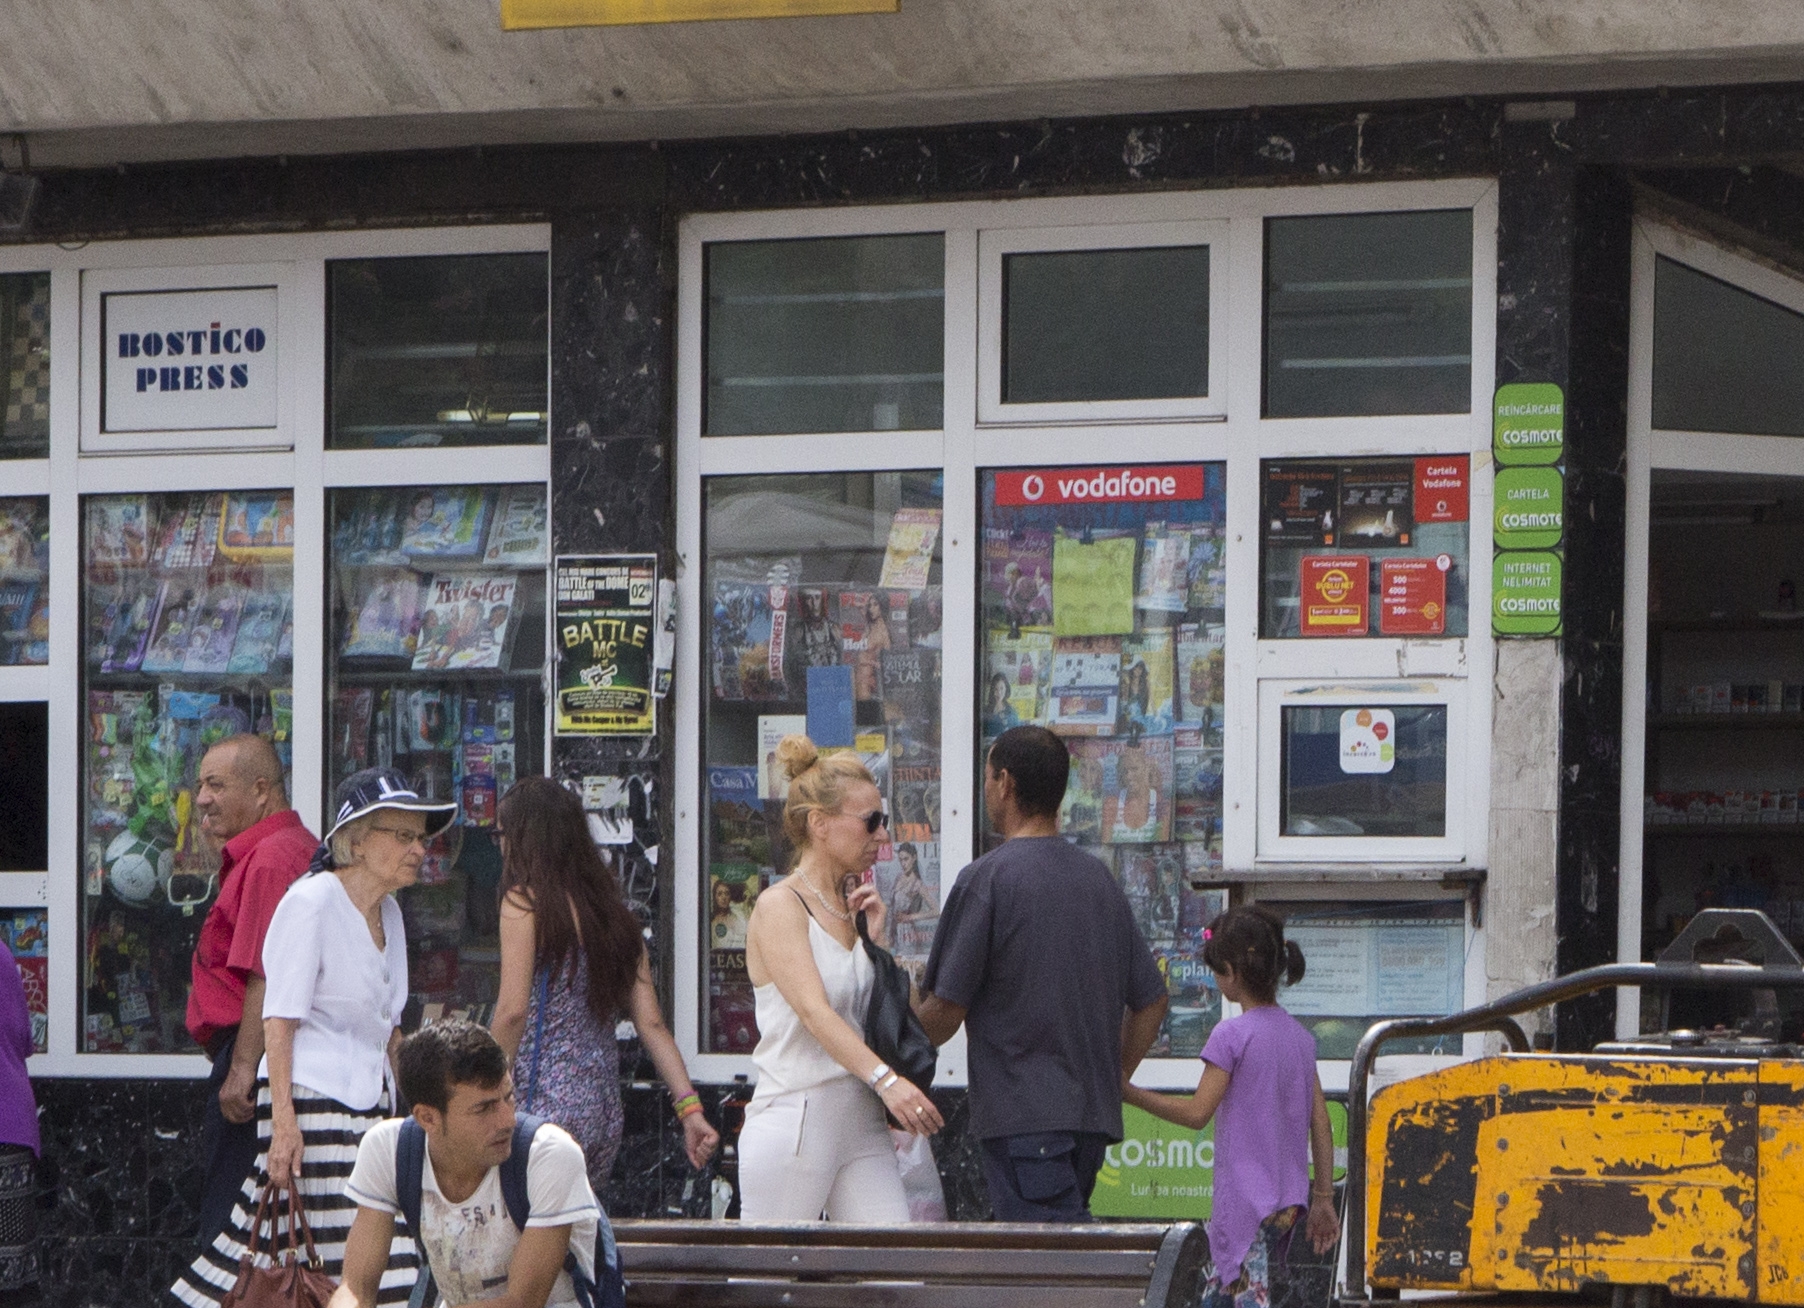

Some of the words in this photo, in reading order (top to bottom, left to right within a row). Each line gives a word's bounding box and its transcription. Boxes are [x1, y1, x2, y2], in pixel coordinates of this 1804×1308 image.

[136, 364, 248, 393] PRESS
[1503, 429, 1562, 444] COSMOTE
[1426, 466, 1457, 476] Cartela
[1058, 470, 1176, 499] vodafone
[1422, 479, 1461, 489] Vodafone
[1507, 489, 1549, 500] CARTELA
[1502, 512, 1562, 527] COSMOTE
[1503, 563, 1551, 575] INTERNET
[558, 576, 587, 590] BATTLE
[1502, 577, 1552, 587] NELIMITAT
[435, 579, 513, 605] Twister
[1500, 597, 1560, 611] COSMOTE
[562, 619, 648, 658] BATTLE
[592, 641, 617, 659] MC
[710, 771, 743, 789] Casa
[1104, 1138, 1215, 1169] COSMO
